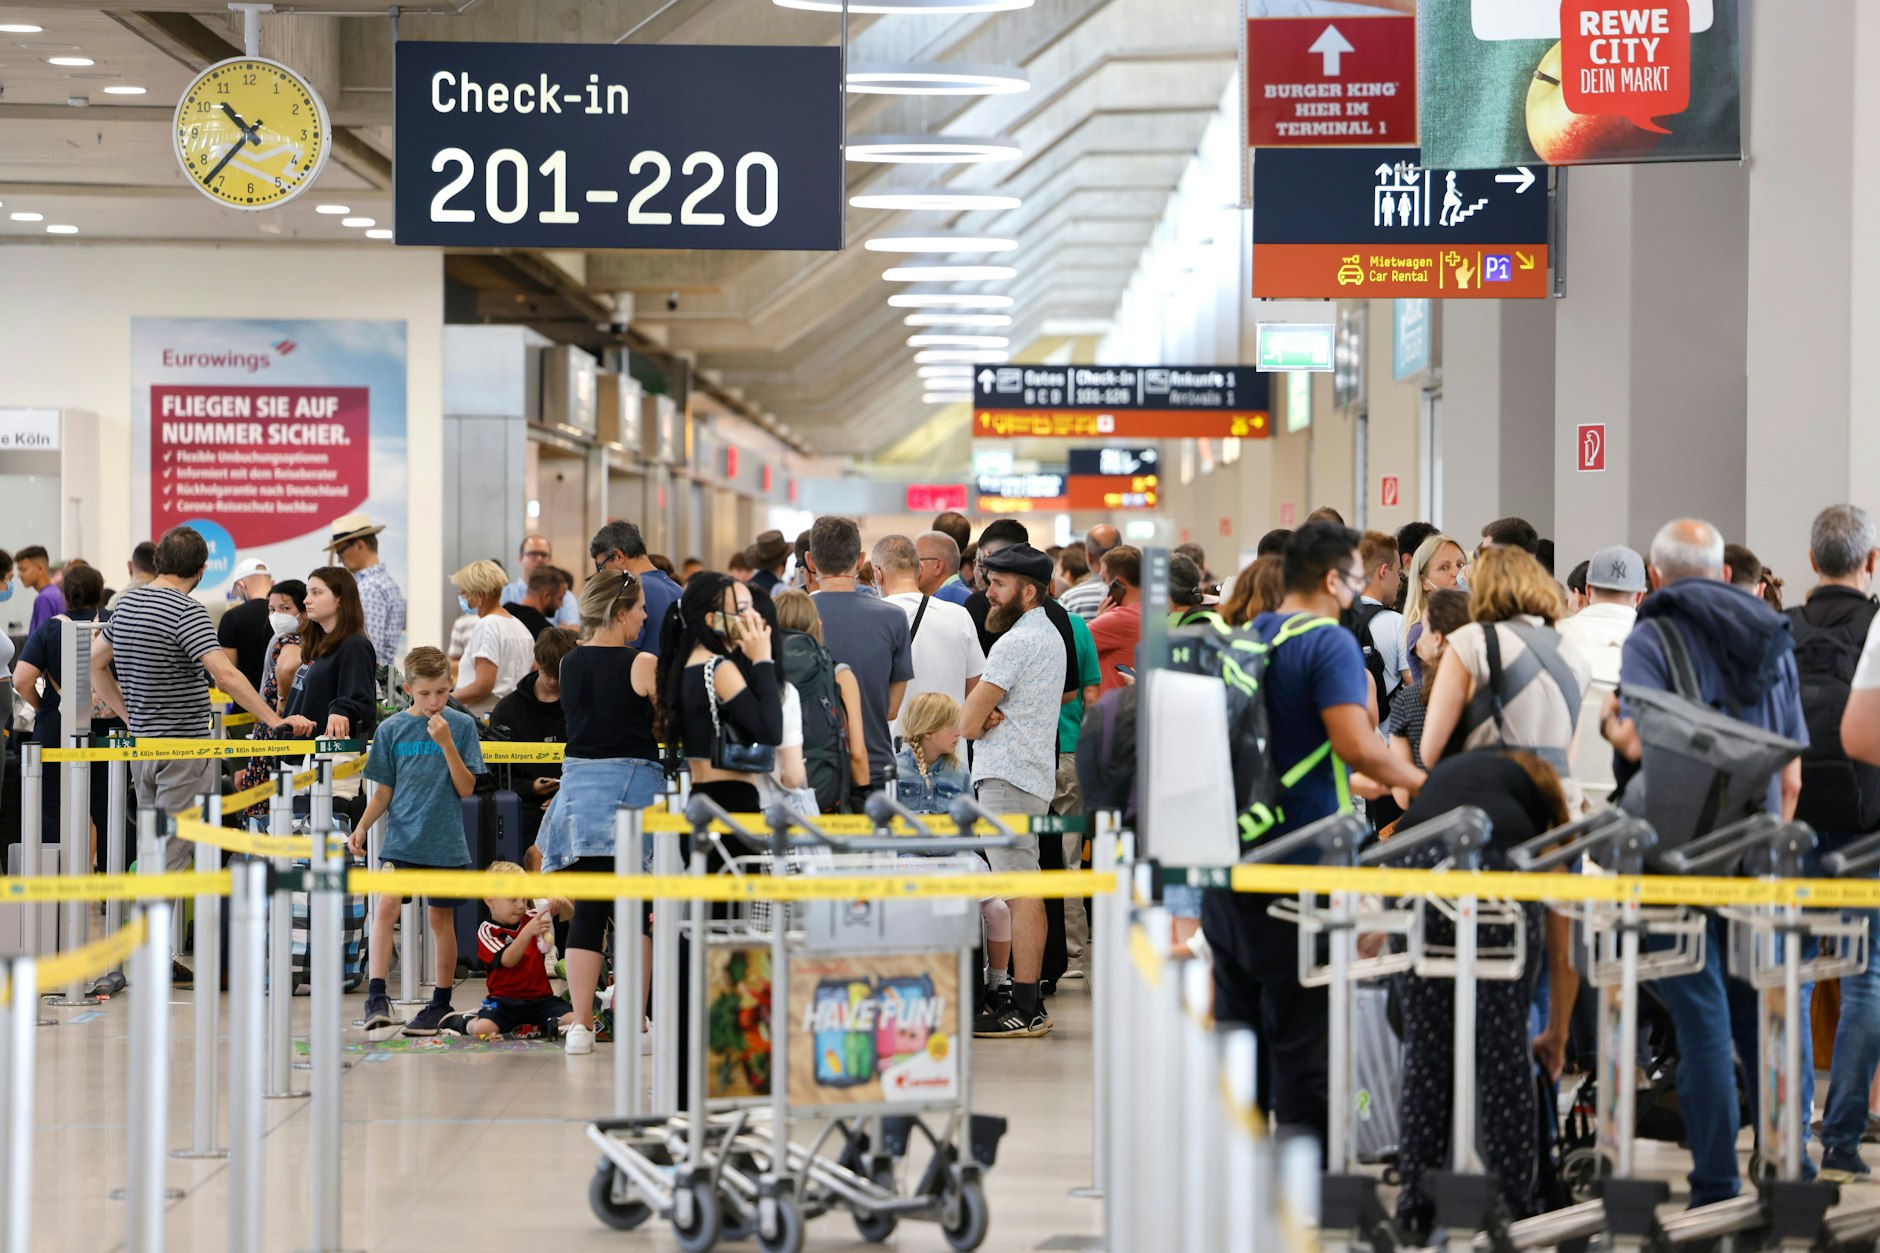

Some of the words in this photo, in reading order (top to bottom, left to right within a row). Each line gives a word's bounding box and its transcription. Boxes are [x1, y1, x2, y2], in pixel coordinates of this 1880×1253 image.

[1579, 8, 1670, 36] REWE
[1589, 37, 1660, 65] CITY
[242, 74, 257, 86] 12
[1580, 67, 1615, 94] DEIN
[1620, 66, 1670, 93] MARKT
[216, 83, 230, 94] 11
[273, 83, 279, 94] 1
[431, 70, 629, 115] Check-in
[1263, 83, 1342, 98] BURGER
[196, 101, 211, 113] 10
[292, 104, 299, 115] 2
[1294, 103, 1342, 117] HIER
[1345, 102, 1369, 116] IM
[191, 128, 198, 139] 9
[1275, 121, 1373, 136] TERMINAL
[1378, 121, 1387, 135] 1
[300, 129, 308, 141] 3
[200, 154, 208, 165] 8
[290, 154, 298, 165] 4
[218, 176, 225, 187] 7
[274, 177, 282, 188] 5
[430, 147, 779, 228] 201-220
[247, 183, 254, 194] 6
[1369, 256, 1433, 270] Mietwagen
[1369, 270, 1388, 282] Car
[1391, 270, 1429, 282] Rental
[162, 349, 271, 374] Eurowings
[161, 395, 251, 418] FLIEGEN
[256, 396, 290, 418] SIE
[295, 396, 340, 419] AUF
[15, 431, 50, 447] Köln
[161, 422, 264, 445] NUMMER
[267, 423, 351, 446] SICHER.
[176, 450, 216, 464] Flexible
[286, 484, 350, 497] Deutschland
[155, 749, 170, 757] Bonn
[171, 748, 195, 757] Airport
[236, 746, 250, 754] Köln
[251, 745, 266, 753] Bonn
[267, 744, 290, 753] Airport
[494, 752, 509, 760] Bonn
[510, 752, 534, 761] Airport
[802, 997, 877, 1034] HAVE
[879, 995, 946, 1031] FUN!
